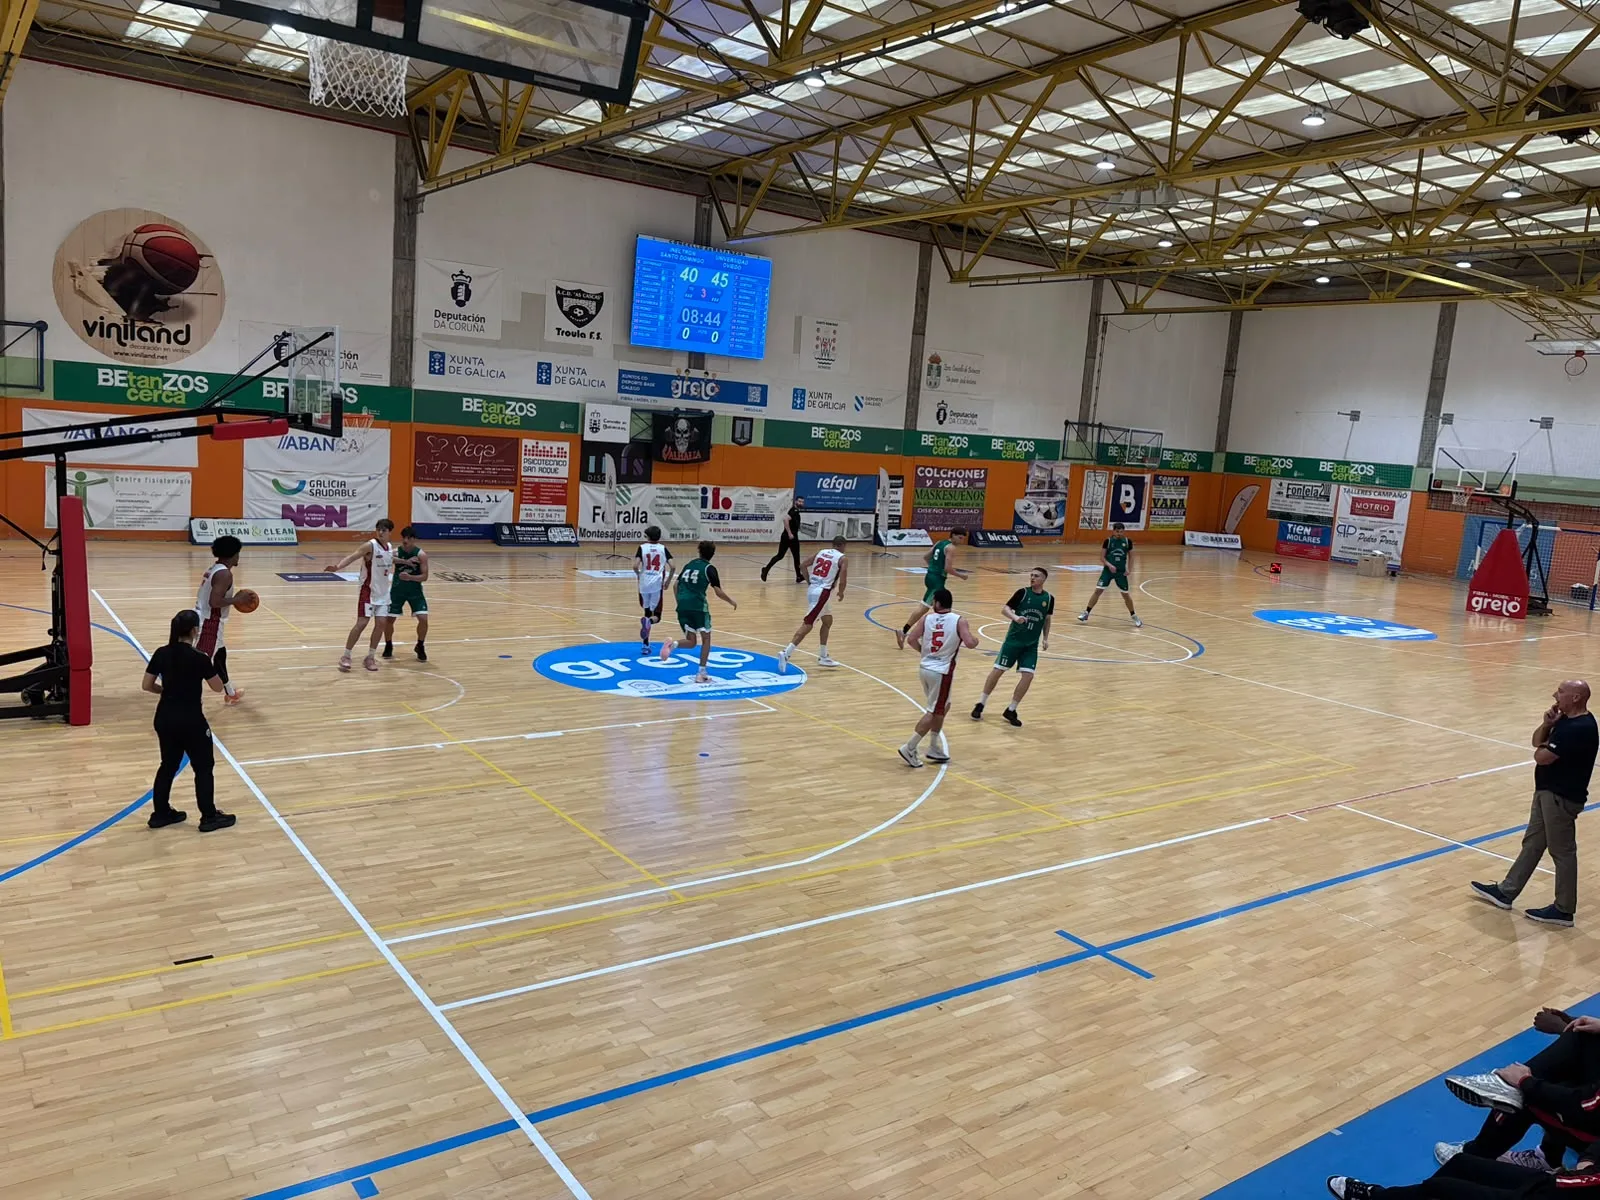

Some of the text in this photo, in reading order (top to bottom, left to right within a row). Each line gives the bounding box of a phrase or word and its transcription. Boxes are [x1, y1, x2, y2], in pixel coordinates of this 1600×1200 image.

[680, 266, 729, 288] 40 45
[700, 288, 707, 299] 3
[434, 309, 486, 324] Deputación
[681, 308, 721, 327] 08:44
[82, 315, 191, 347] viniland
[434, 319, 485, 333] DA CORUÑA
[555, 327, 587, 339] Troula
[682, 327, 719, 343] 0 0
[113, 350, 168, 361] www.viniland.net
[449, 354, 485, 367] XUNTA
[448, 365, 506, 380] DE GALICIA
[555, 365, 588, 377] XUNTA
[554, 375, 607, 389] DE GALICIA
[621, 379, 643, 388] DEPORTE
[126, 388, 187, 405] cerca
[808, 391, 833, 401] XUNTA
[807, 400, 847, 411] DE GALICIA
[481, 411, 521, 426] cerca
[949, 409, 978, 419] Deputación
[956, 418, 977, 426] CORUÑA
[823, 438, 850, 449] cerca
[662, 443, 702, 461] VALHALLA
[932, 445, 958, 456] cerca
[1001, 449, 1025, 460] cerca
[522, 457, 567, 468] PSICOTECNICO
[1169, 460, 1190, 470] cerca
[538, 467, 559, 475] ROQUE
[916, 466, 985, 479] COLCHONES
[1254, 464, 1281, 475] cerca
[937, 477, 969, 488] SOFÁS
[1331, 472, 1361, 483] cerca
[308, 479, 347, 489] GALICIA
[817, 475, 857, 493] refgal
[308, 488, 357, 498] SAUDABLE
[914, 487, 985, 501] MASKESUEÑOS
[1342, 487, 1408, 499] TALLERES CAMPAÑO
[1152, 497, 1186, 509] VARA
[281, 504, 348, 528] NON
[592, 505, 649, 524] Feralla
[217, 525, 295, 537] CLEAN & CLEAN
[987, 531, 1019, 542] bicoca
[1223, 536, 1239, 544] KIKO
[1286, 533, 1321, 545] MOLARES
[1357, 532, 1378, 543] Pedro
[645, 553, 661, 572] 14
[812, 557, 833, 578] 29
[1271, 564, 1282, 572] 24
[681, 568, 700, 584] 44
[1471, 596, 1521, 616] grelo
[1027, 622, 1034, 631] 11
[930, 631, 945, 654] 5
[550, 651, 755, 680] grelo
